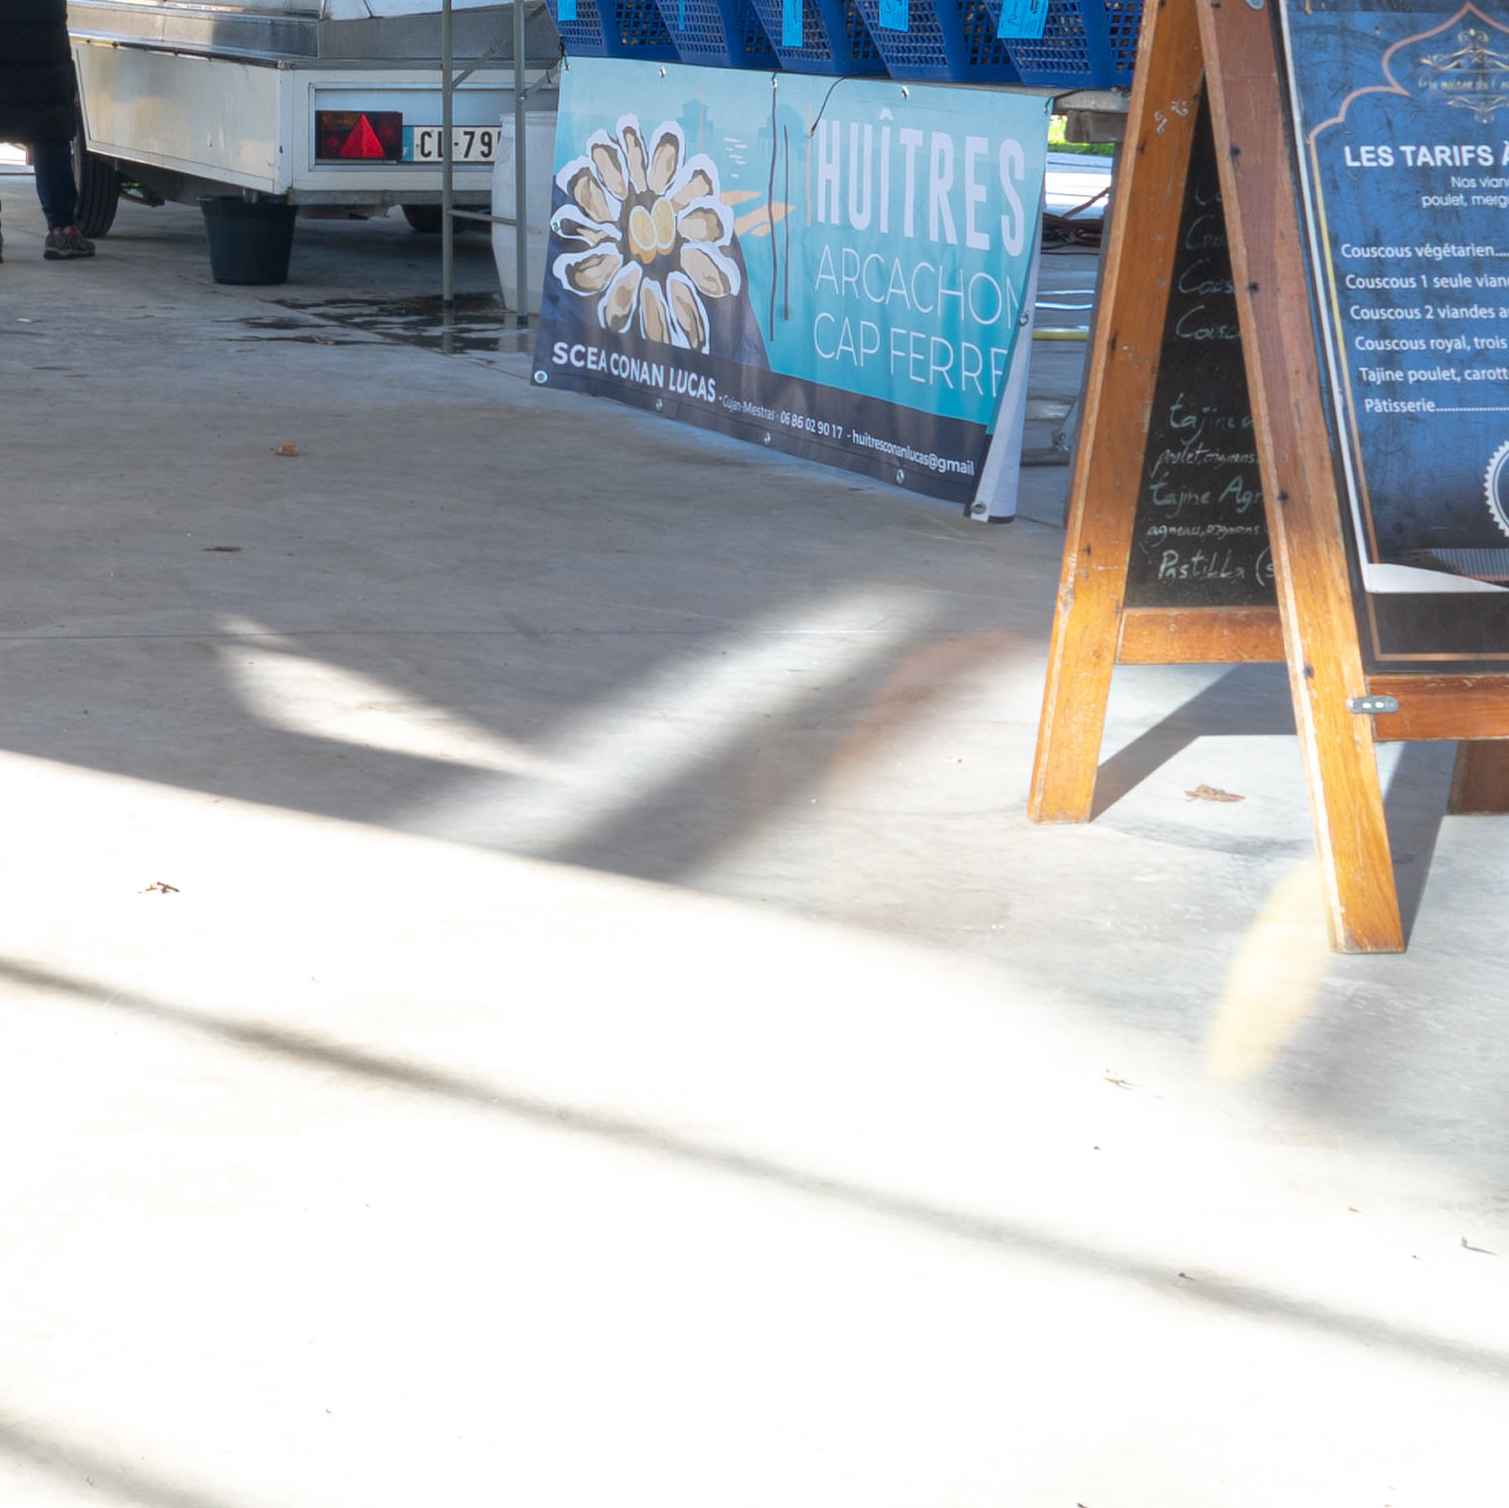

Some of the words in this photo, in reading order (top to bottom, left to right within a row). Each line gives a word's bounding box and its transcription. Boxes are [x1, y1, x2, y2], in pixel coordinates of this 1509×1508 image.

[1344, 145, 1394, 167] LES
[1400, 144, 1494, 167] TARIFS
[817, 108, 1025, 257] HUÎTRES
[1451, 175, 1477, 189] Nos
[1479, 175, 1509, 189] vian
[1422, 194, 1468, 208] poulet,
[1471, 195, 1509, 209] merg
[1341, 243, 1412, 259] Couscous
[1345, 274, 1417, 289] Couscous
[1420, 275, 1428, 288] 1
[1433, 273, 1472, 289] seule
[1475, 273, 1509, 288] vian
[1350, 305, 1421, 320] Couscous
[1424, 305, 1434, 319] 2
[1437, 304, 1496, 319] viandes
[1499, 307, 1509, 319] a
[814, 312, 880, 367] CAP
[1355, 336, 1426, 351] Couscous
[1429, 335, 1471, 353] royal,
[1473, 335, 1508, 350] trois
[1359, 367, 1404, 385] Tajine
[1408, 366, 1461, 384] poulet,
[552, 341, 608, 373] SCEA
[610, 352, 665, 389] CONAN
[669, 367, 717, 404] LUCAS
[791, 413, 804, 429] 86
[805, 417, 816, 433] 02
[817, 420, 830, 436] 90
[832, 424, 843, 440] 17
